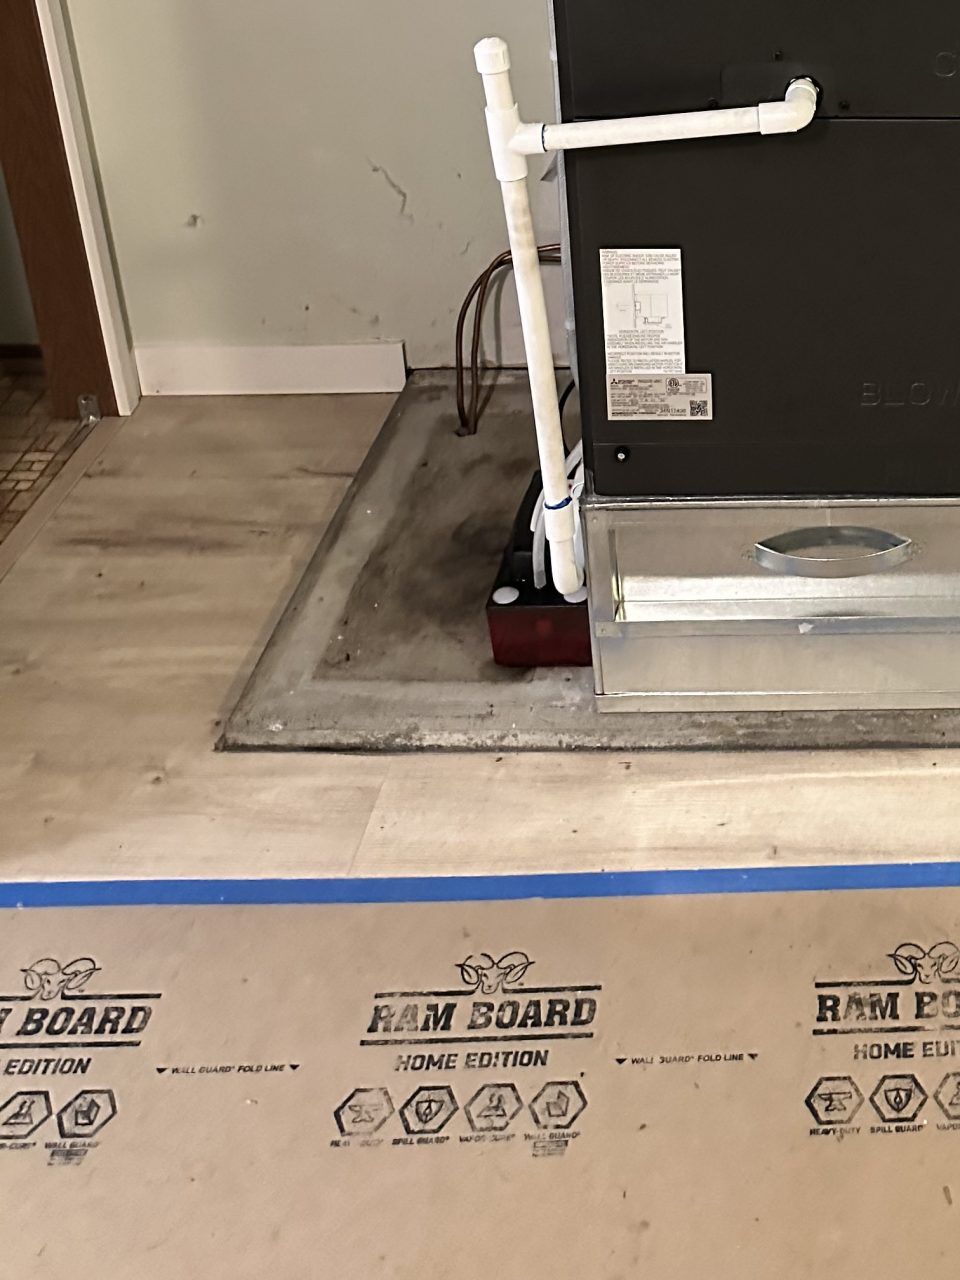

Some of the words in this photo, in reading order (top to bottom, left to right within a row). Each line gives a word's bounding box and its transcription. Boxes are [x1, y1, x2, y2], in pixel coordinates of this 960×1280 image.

[367, 1001, 457, 1033] RAM
[467, 997, 597, 1030] BOARD
[816, 991, 900, 1022] RAM
[16, 1006, 152, 1036] BOARD
[395, 1053, 458, 1072] HOME
[464, 1049, 549, 1069] EDITION
[697, 1053, 722, 1062] FOLD
[723, 1053, 744, 1061] LINE
[853, 1042, 915, 1061] HOME
[3, 1057, 92, 1075] EDITION
[237, 1064, 262, 1073] FOLD
[264, 1063, 286, 1072] LINE
